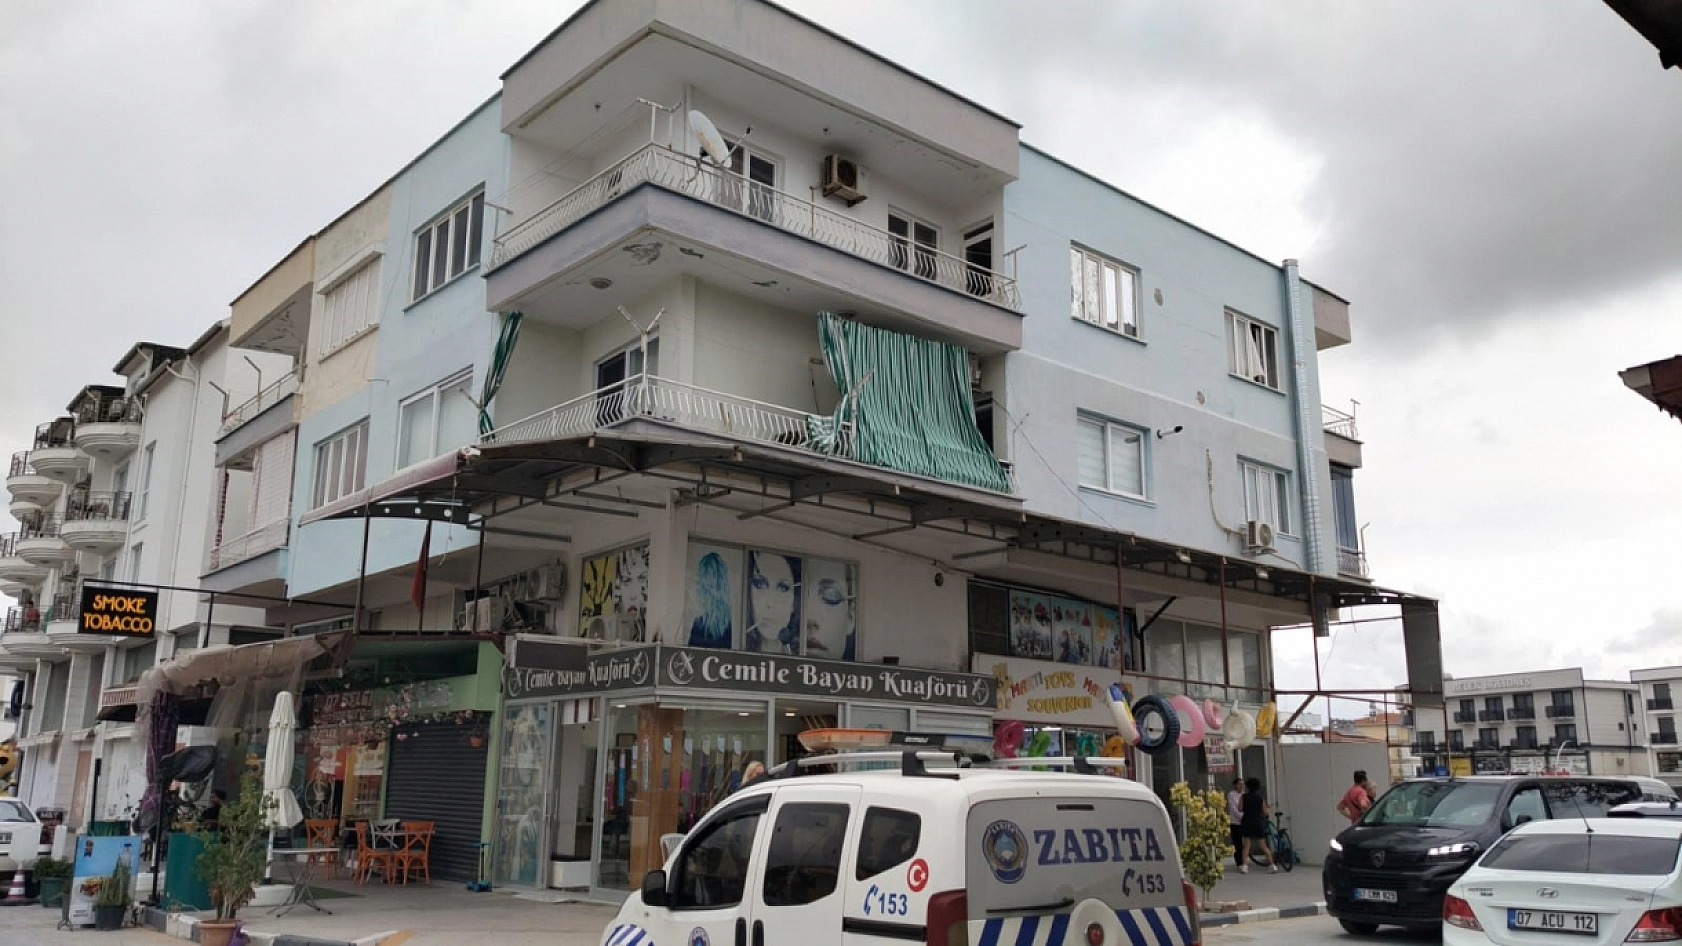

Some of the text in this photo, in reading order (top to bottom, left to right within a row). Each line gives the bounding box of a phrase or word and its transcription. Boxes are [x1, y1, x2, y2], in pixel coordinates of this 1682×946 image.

[92, 593, 147, 614] SMOKE
[84, 612, 153, 633] TOBACCO
[524, 668, 555, 692] Cemile
[588, 657, 631, 688] Kuaförü
[702, 656, 968, 699] Cemile Bayan Kuaförü
[1044, 670, 1076, 690] TOYS
[1034, 828, 1165, 866] ZABITA
[1137, 874, 1165, 894] 153
[878, 892, 908, 915] 153
[1517, 912, 1594, 930] 07 ACU 112
